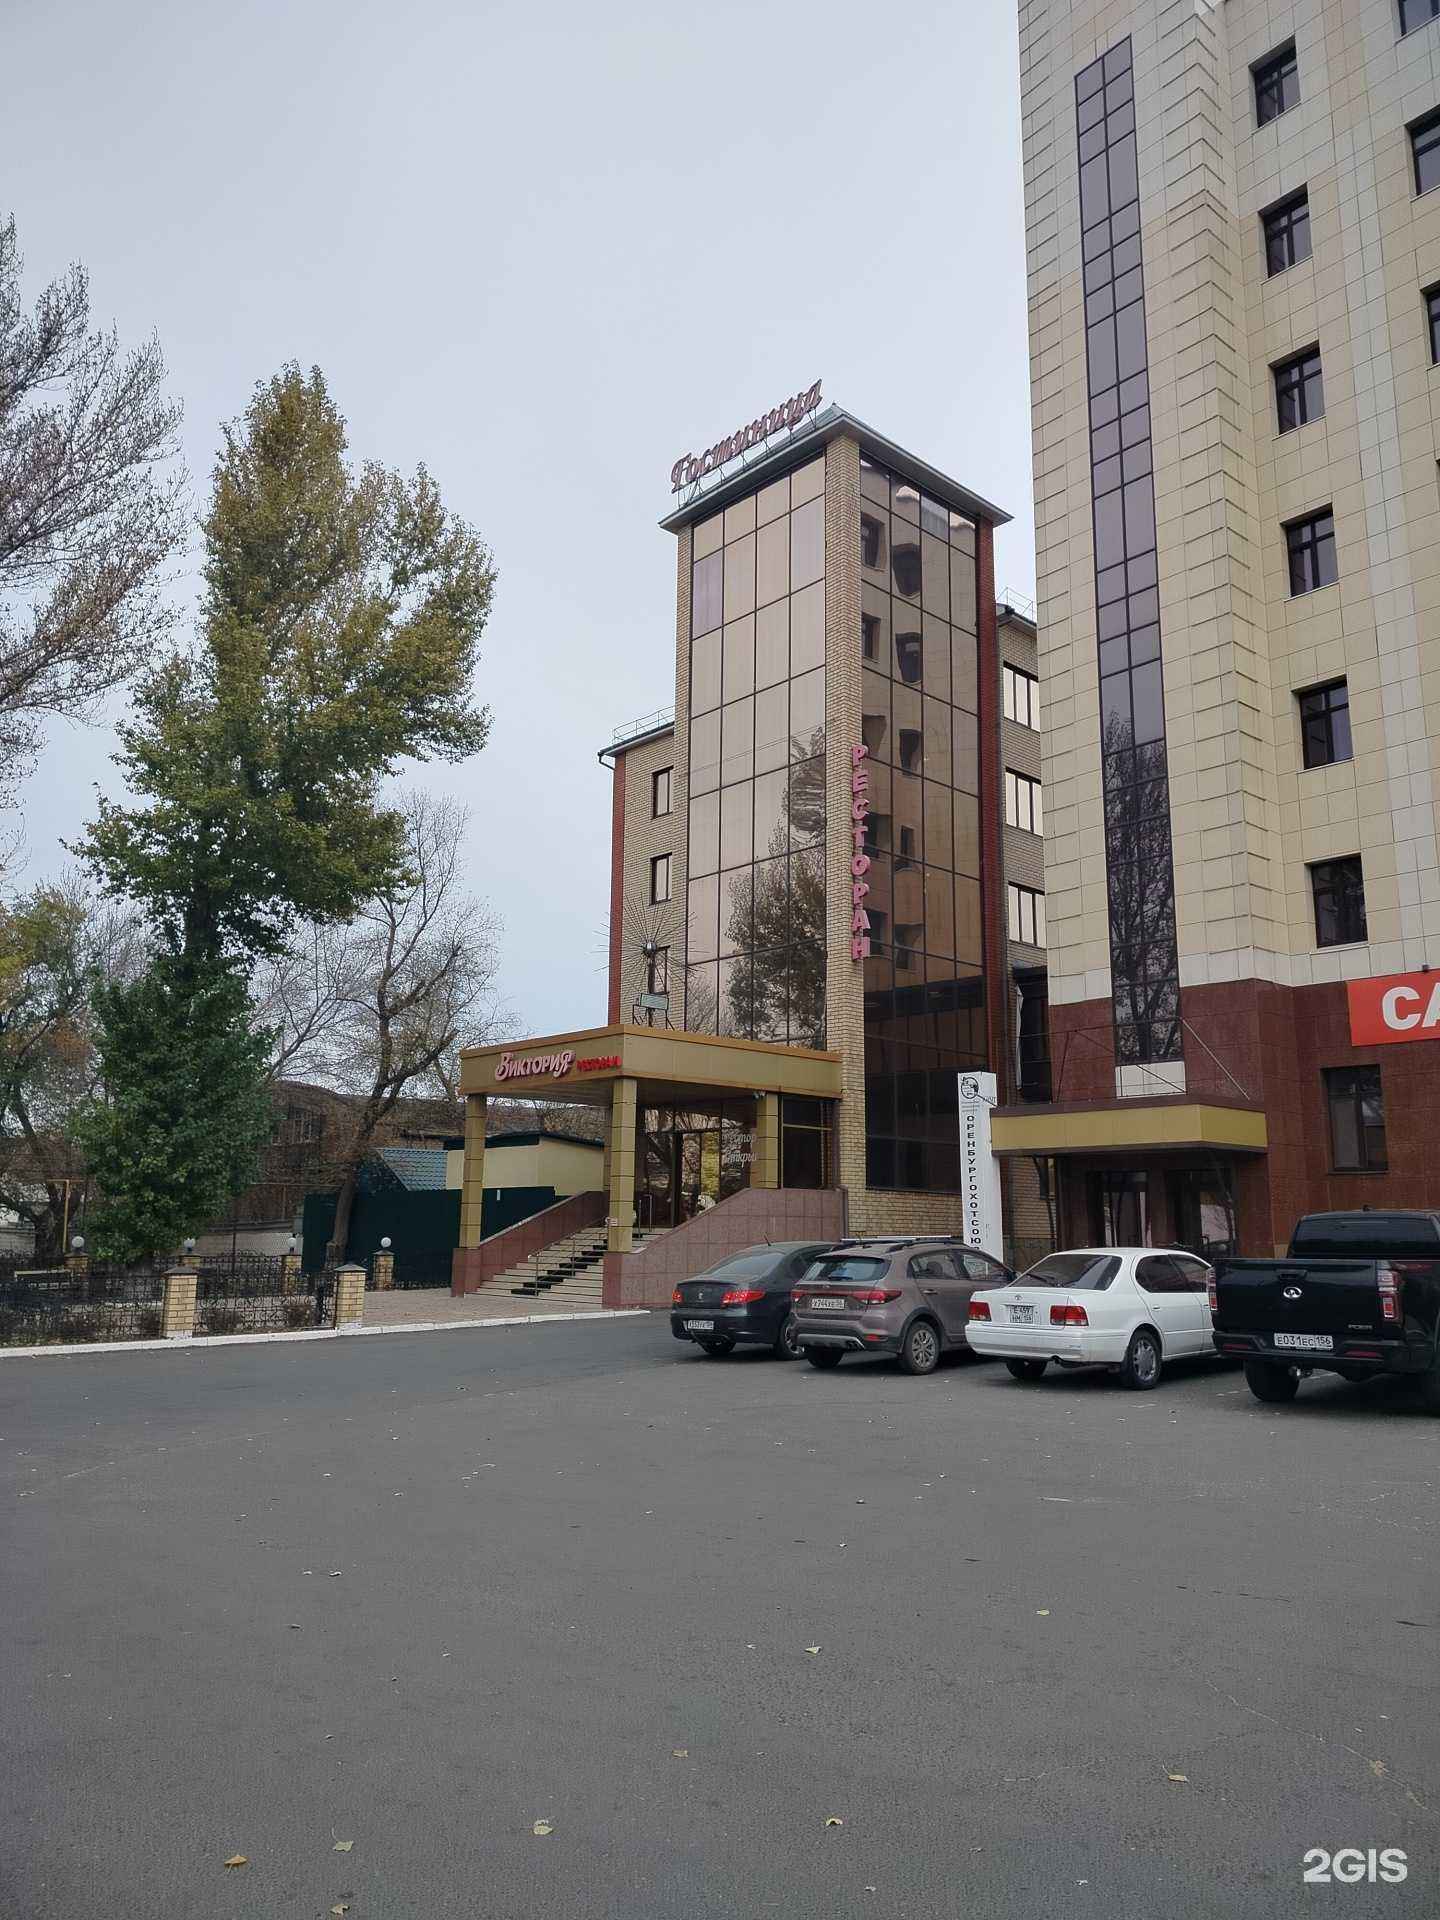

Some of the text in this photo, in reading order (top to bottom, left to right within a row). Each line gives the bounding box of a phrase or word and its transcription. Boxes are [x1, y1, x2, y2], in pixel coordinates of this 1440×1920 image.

[671, 378, 823, 493] Гостиница
[851, 744, 871, 961] РЕСТОРАН
[967, 1115, 981, 1250] ОРЕНБУРГОХОТСОЮ
